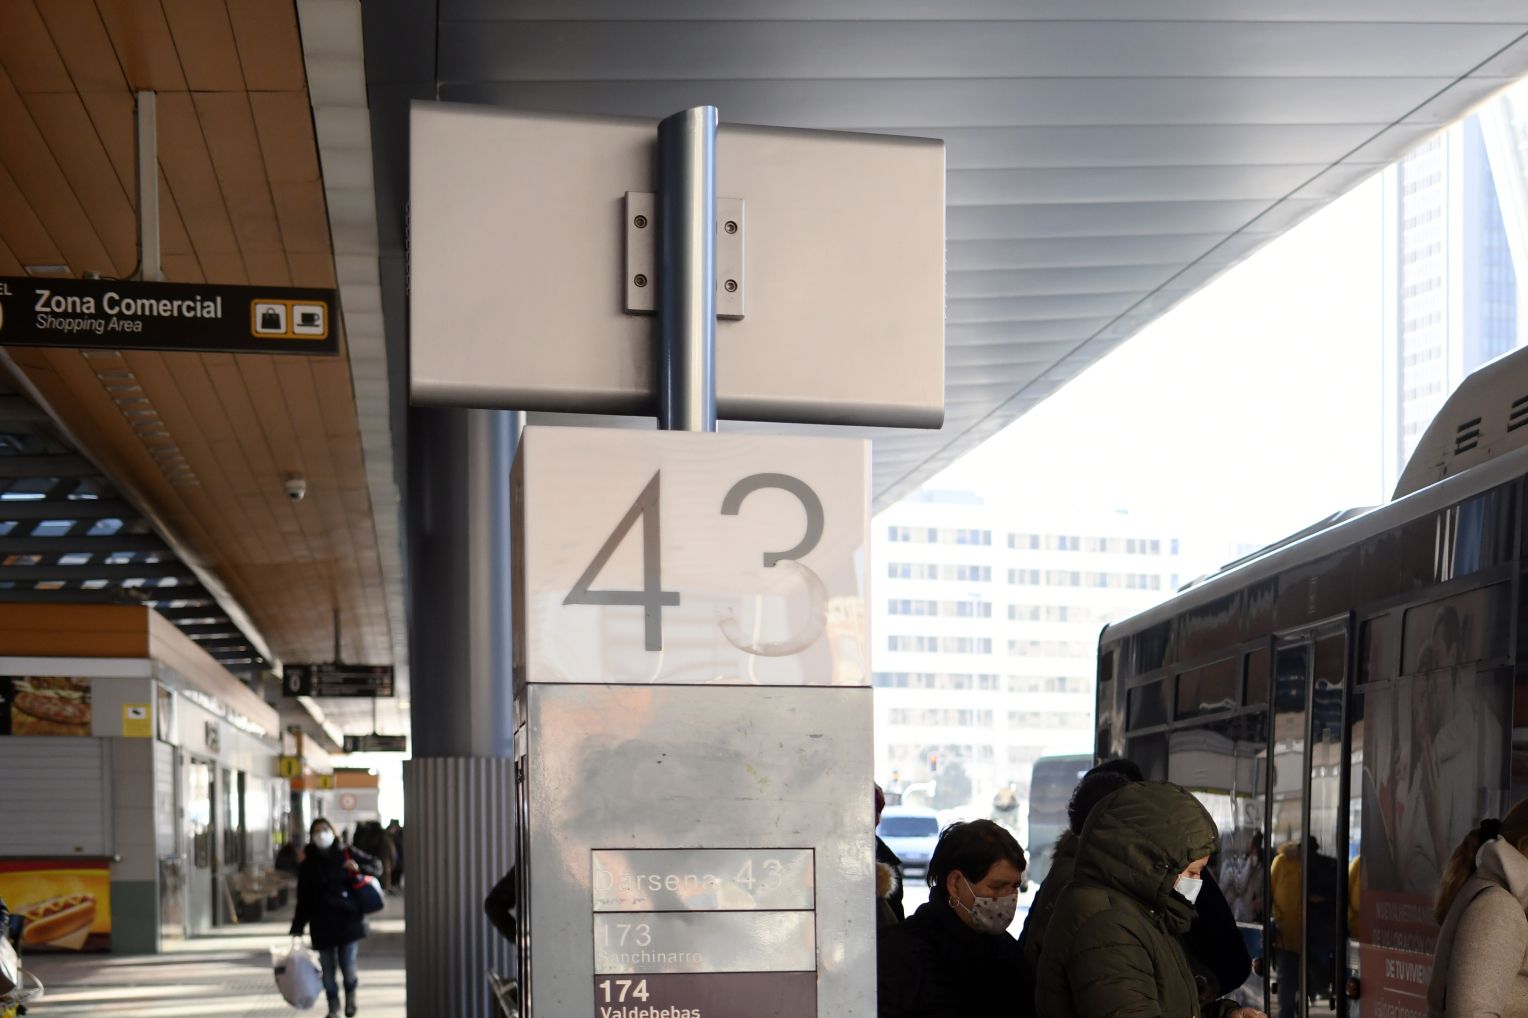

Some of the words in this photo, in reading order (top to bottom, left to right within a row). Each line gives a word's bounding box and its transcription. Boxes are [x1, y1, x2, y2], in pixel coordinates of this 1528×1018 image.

[34, 289, 96, 315] Zona
[101, 292, 223, 320] Comercial
[35, 313, 105, 335] Shopping
[107, 316, 143, 334] Area
[562, 467, 829, 658] 43
[735, 858, 784, 891] 43
[603, 923, 652, 947] 173
[598, 949, 704, 965] Sanchinarro
[1384, 957, 1395, 979] DE
[1395, 960, 1405, 981] TU
[599, 979, 650, 1003] 174
